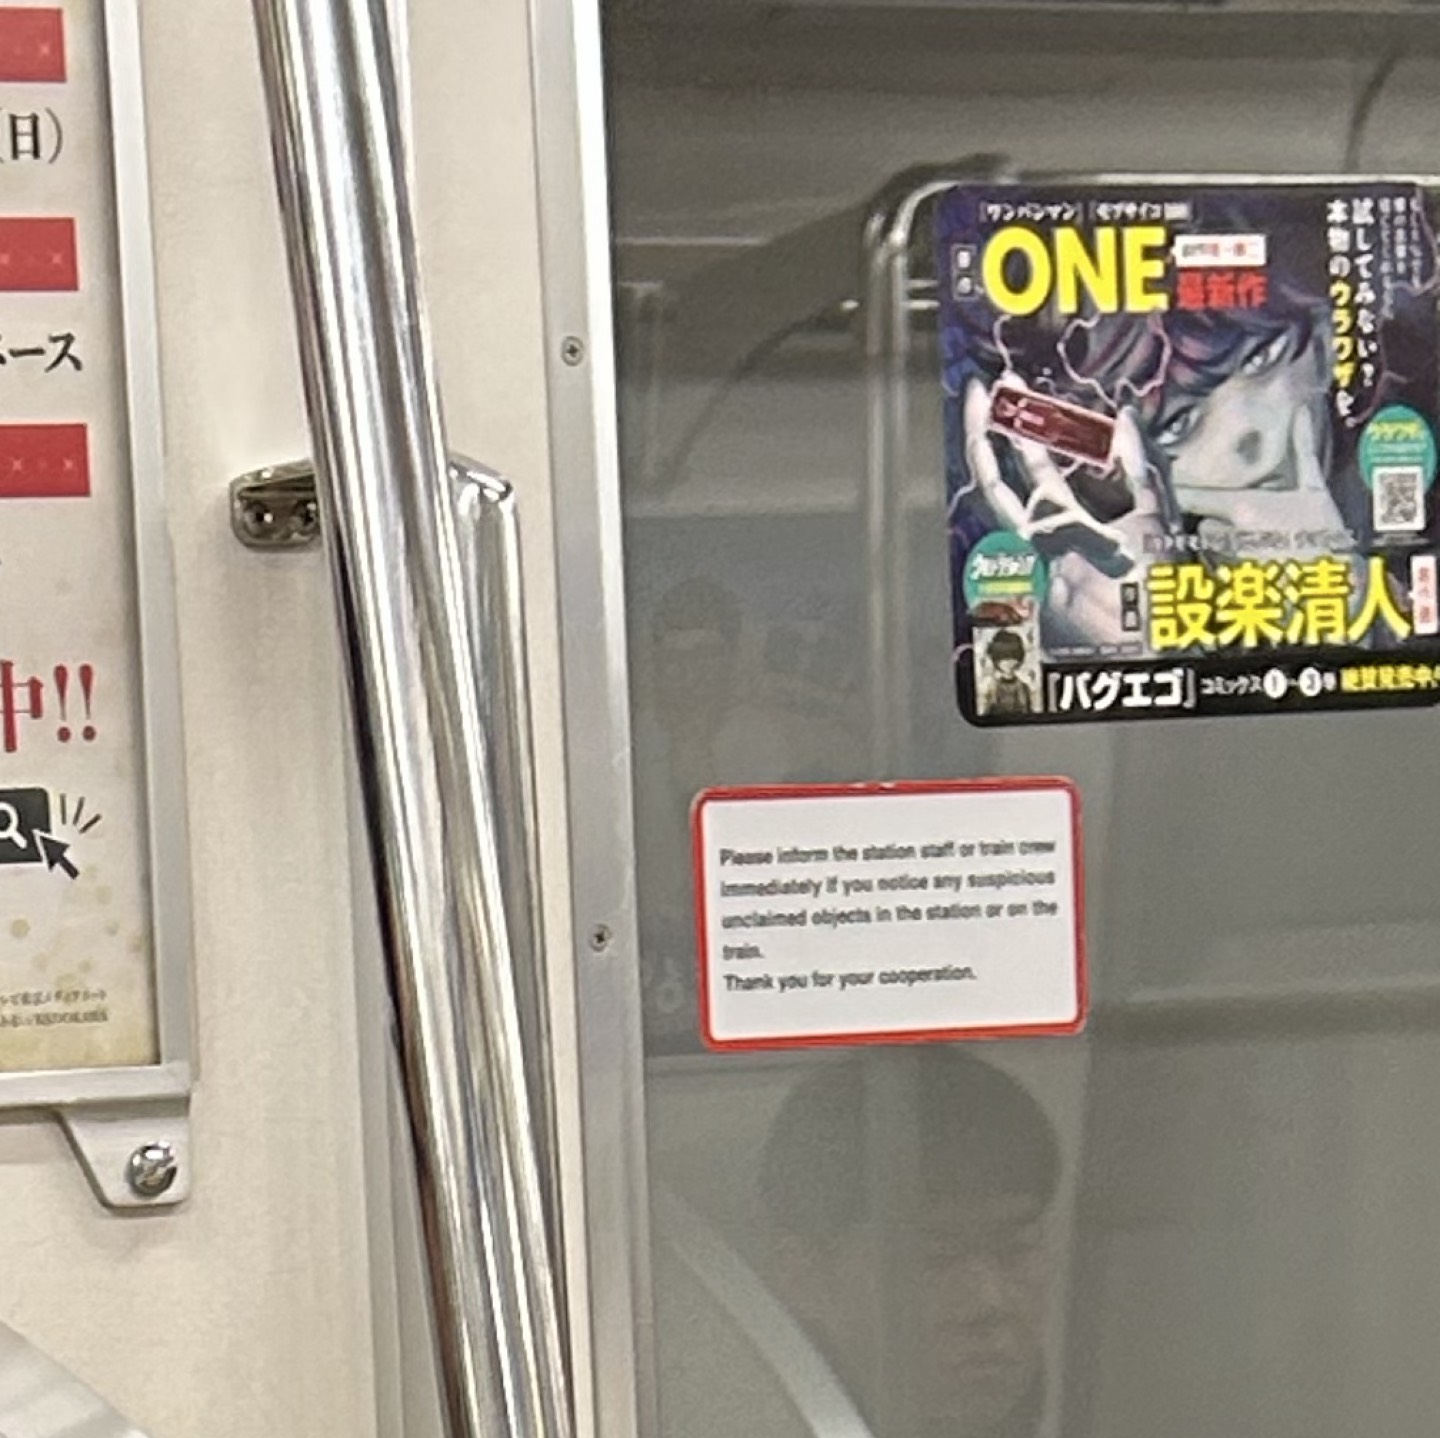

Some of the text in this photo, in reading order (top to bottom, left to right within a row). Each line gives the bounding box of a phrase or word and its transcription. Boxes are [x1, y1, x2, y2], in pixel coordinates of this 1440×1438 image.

[982, 227, 1170, 316] ONE
[1146, 555, 1411, 651] 設楽清人
[720, 848, 773, 866] Please
[777, 846, 829, 864] inform
[833, 846, 858, 861] the
[862, 844, 916, 861] station
[920, 841, 955, 858] staff
[960, 843, 974, 857] or
[979, 840, 1015, 856] train
[826, 876, 838, 893] if
[842, 878, 873, 897] you
[878, 874, 929, 891] notice
[933, 875, 962, 893] any
[967, 871, 1056, 890] suspicious
[722, 900, 1058, 929] unclaimed objects in the station or on the
[722, 965, 977, 993] Thank you for your cooperation.
